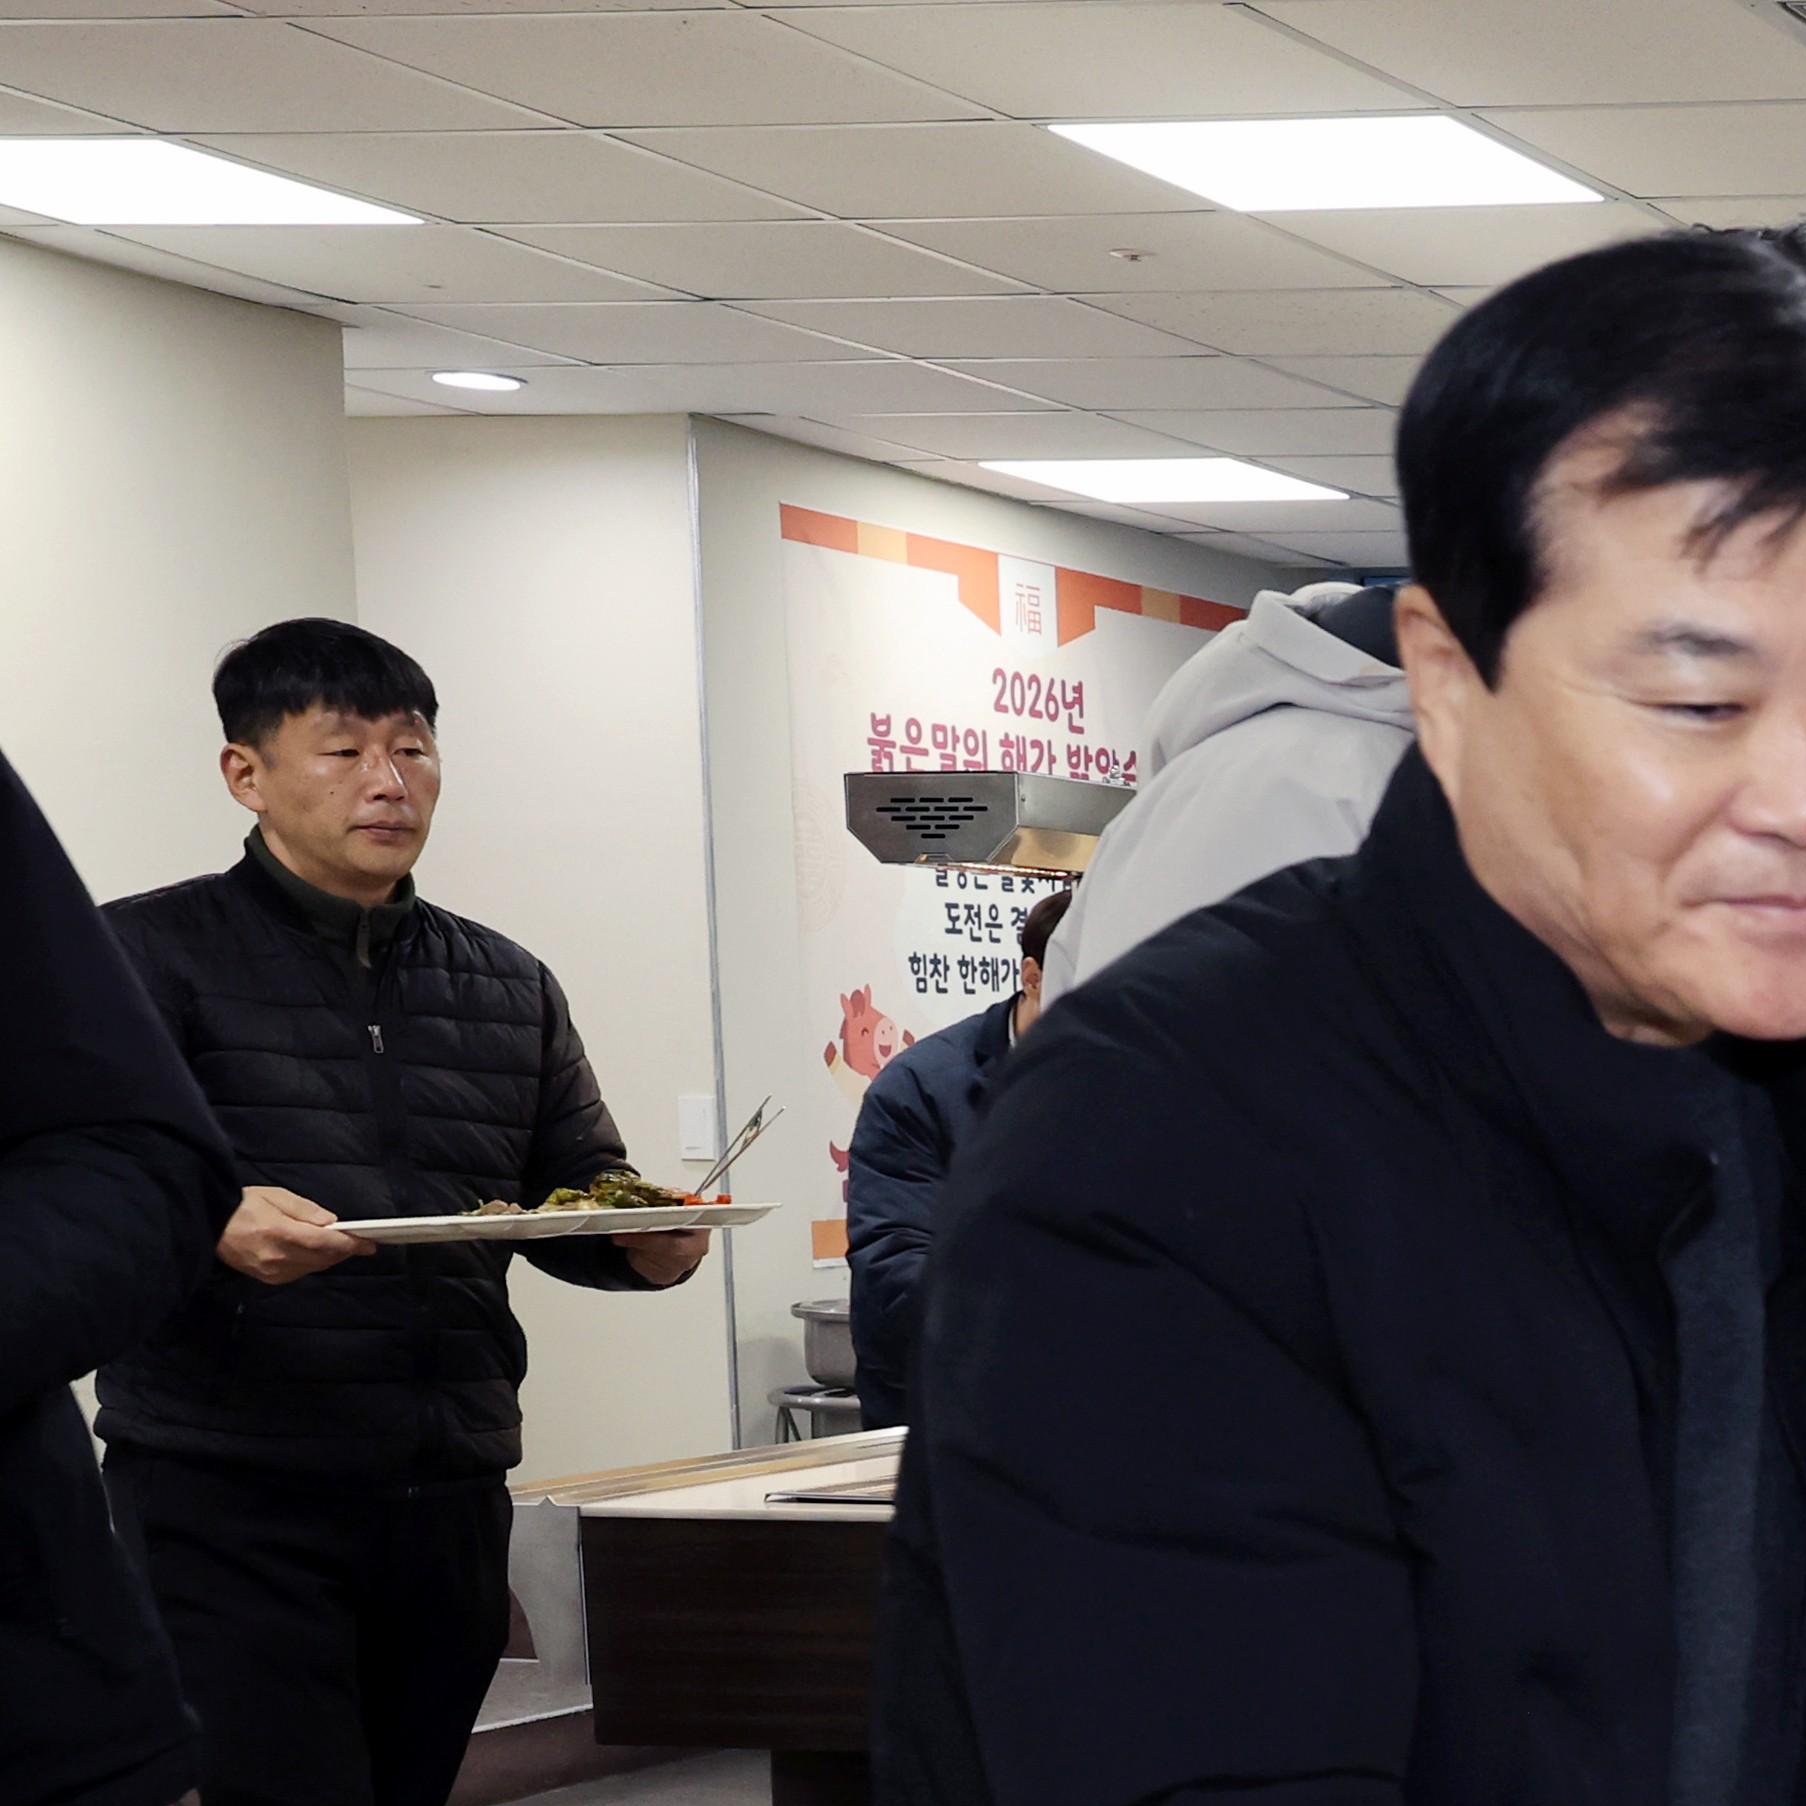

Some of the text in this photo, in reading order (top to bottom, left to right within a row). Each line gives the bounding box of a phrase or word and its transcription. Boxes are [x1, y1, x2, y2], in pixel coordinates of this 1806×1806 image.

[1014, 582, 1043, 635] 福
[991, 667, 1085, 735] 2026년
[998, 731, 1057, 776] 해가
[944, 901, 1004, 944] 도전은
[907, 951, 1021, 995] 힘찬 한해가
